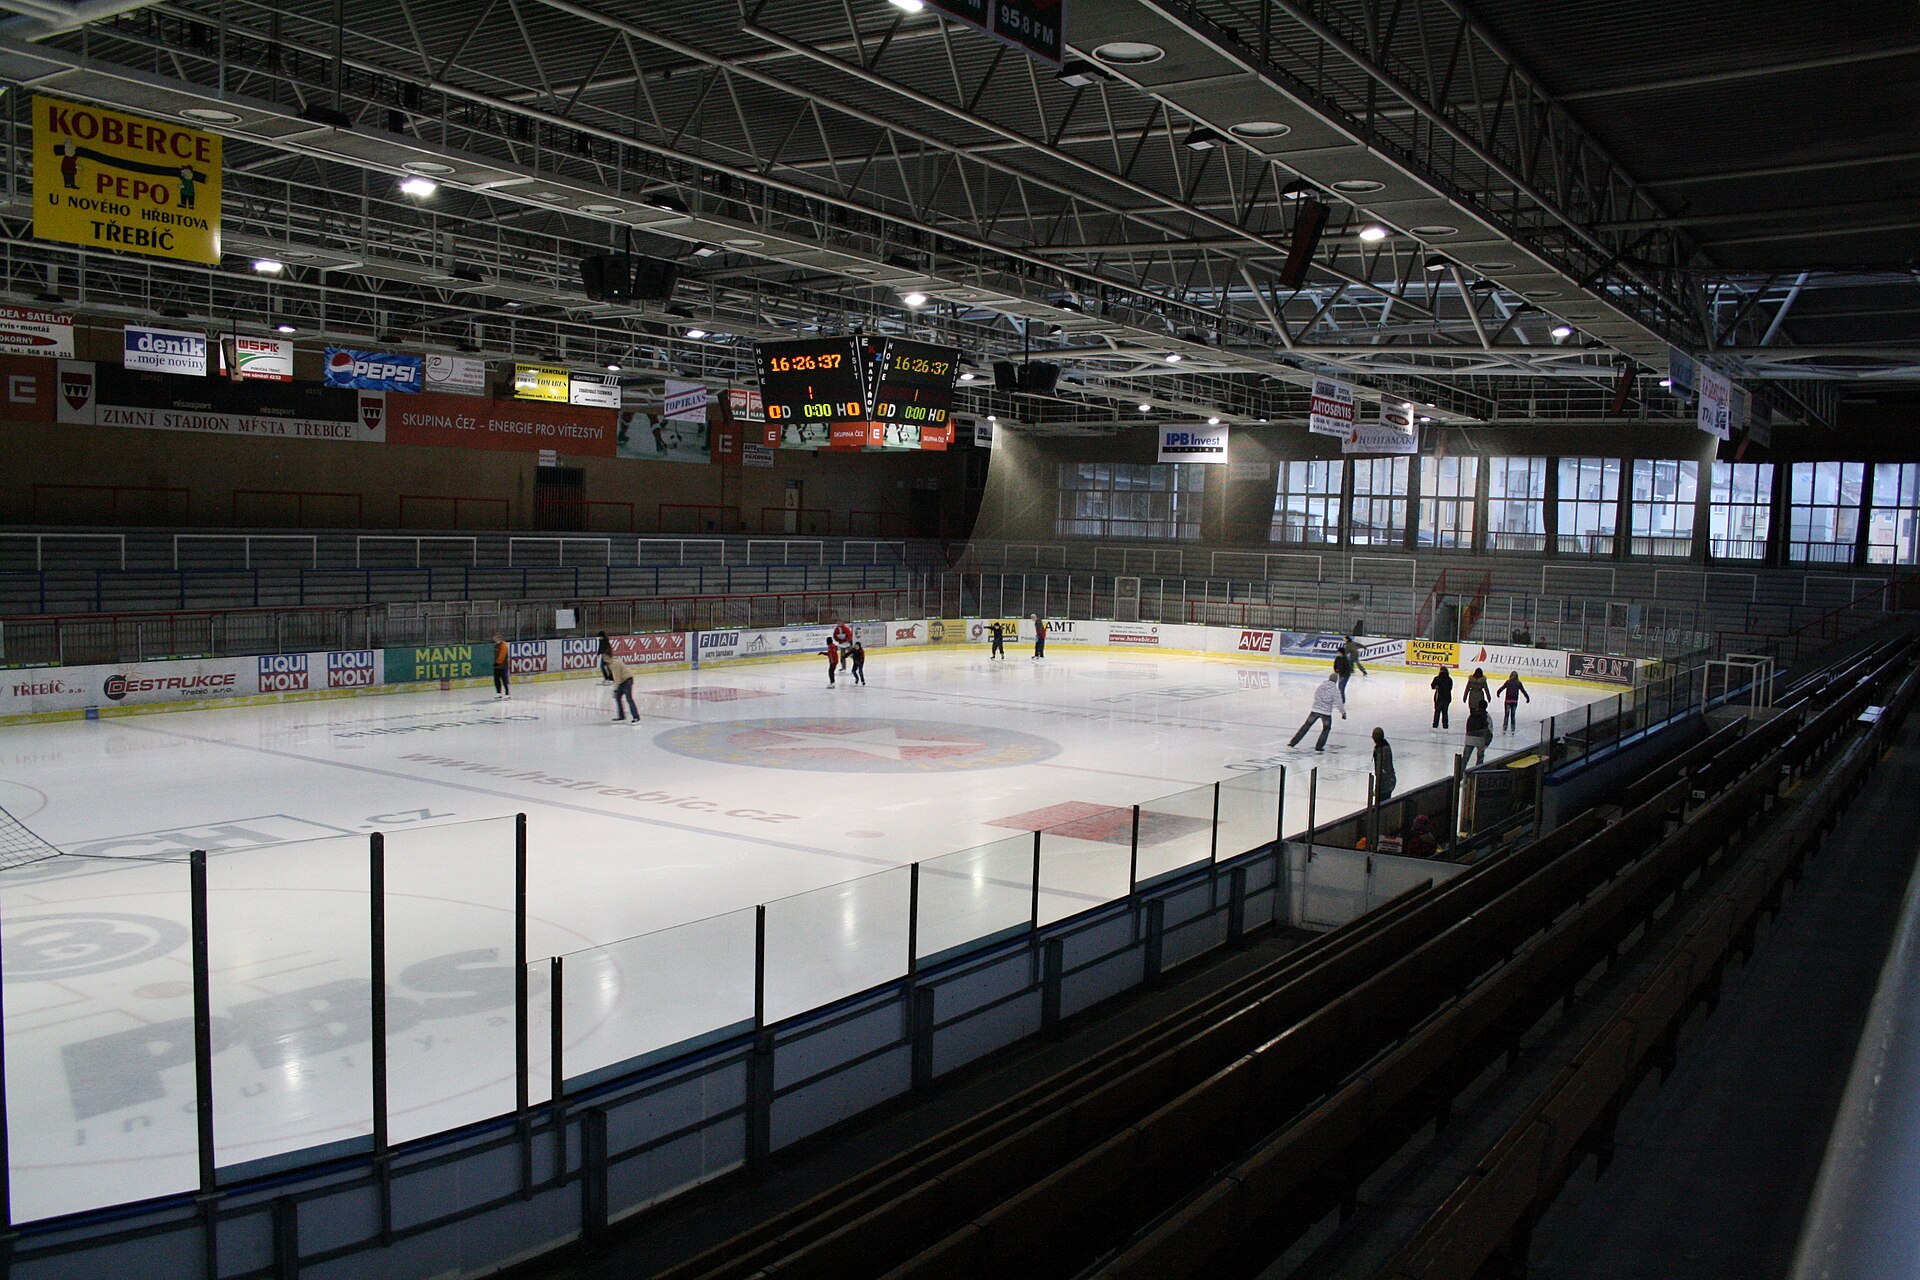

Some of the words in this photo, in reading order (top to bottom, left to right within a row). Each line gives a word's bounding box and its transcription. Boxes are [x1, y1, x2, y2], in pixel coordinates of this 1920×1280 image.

[1034, 21, 1054, 46] FM
[49, 106, 210, 163] KOBERCE
[96, 173, 170, 205] PEPO
[49, 193, 59, 205] U
[68, 196, 131, 217] NOVÉHO
[142, 208, 208, 230] HŘBITOVA
[91, 219, 174, 250] TŘEBÍČ
[26, 312, 73, 324] SATELITY
[138, 333, 205, 358] deník
[168, 358, 206, 371] noviny
[756, 348, 766, 385] HOME
[770, 354, 842, 372] 16:26:37
[850, 341, 859, 380] VISIT
[882, 342, 894, 382] HOME
[894, 356, 949, 376] 16:26:37
[353, 360, 416, 383] PEPSI
[666, 394, 706, 412] TOPTRANS
[104, 409, 154, 426] ZIMNÍ
[164, 414, 230, 432] STADION
[294, 421, 352, 439] TŘEBÍČE
[402, 413, 452, 429] SKUPINA
[455, 413, 476, 430] ČEZ
[488, 419, 532, 435] ENERGIE
[535, 423, 555, 436] PRO
[558, 422, 604, 440] VÍTĚZSTVÍ
[1166, 432, 1190, 445] IPB
[1191, 433, 1220, 445] Invest
[1358, 435, 1416, 446] HUHTAMAKI
[1046, 622, 1075, 632] AMT
[510, 641, 546, 658] LIQUI
[563, 640, 596, 654] LIQUI
[701, 634, 738, 648] FIAT
[1240, 636, 1272, 650] AVE
[1360, 642, 1403, 657] OPTRANS
[1413, 642, 1454, 651] KOBERCE
[328, 651, 373, 670] LIQUI
[415, 646, 472, 664] MANN
[563, 654, 597, 669] MOLY
[1490, 653, 1560, 669] HUHTAMAKI
[260, 656, 306, 674] LIQUI
[415, 662, 472, 680] FILTER
[510, 656, 546, 673] MOLY
[108, 674, 236, 694] DESTRUKCE
[260, 673, 308, 692] MOLY
[330, 669, 373, 687] MOLY
[400, 752, 799, 823] www.hstrebic.cz
